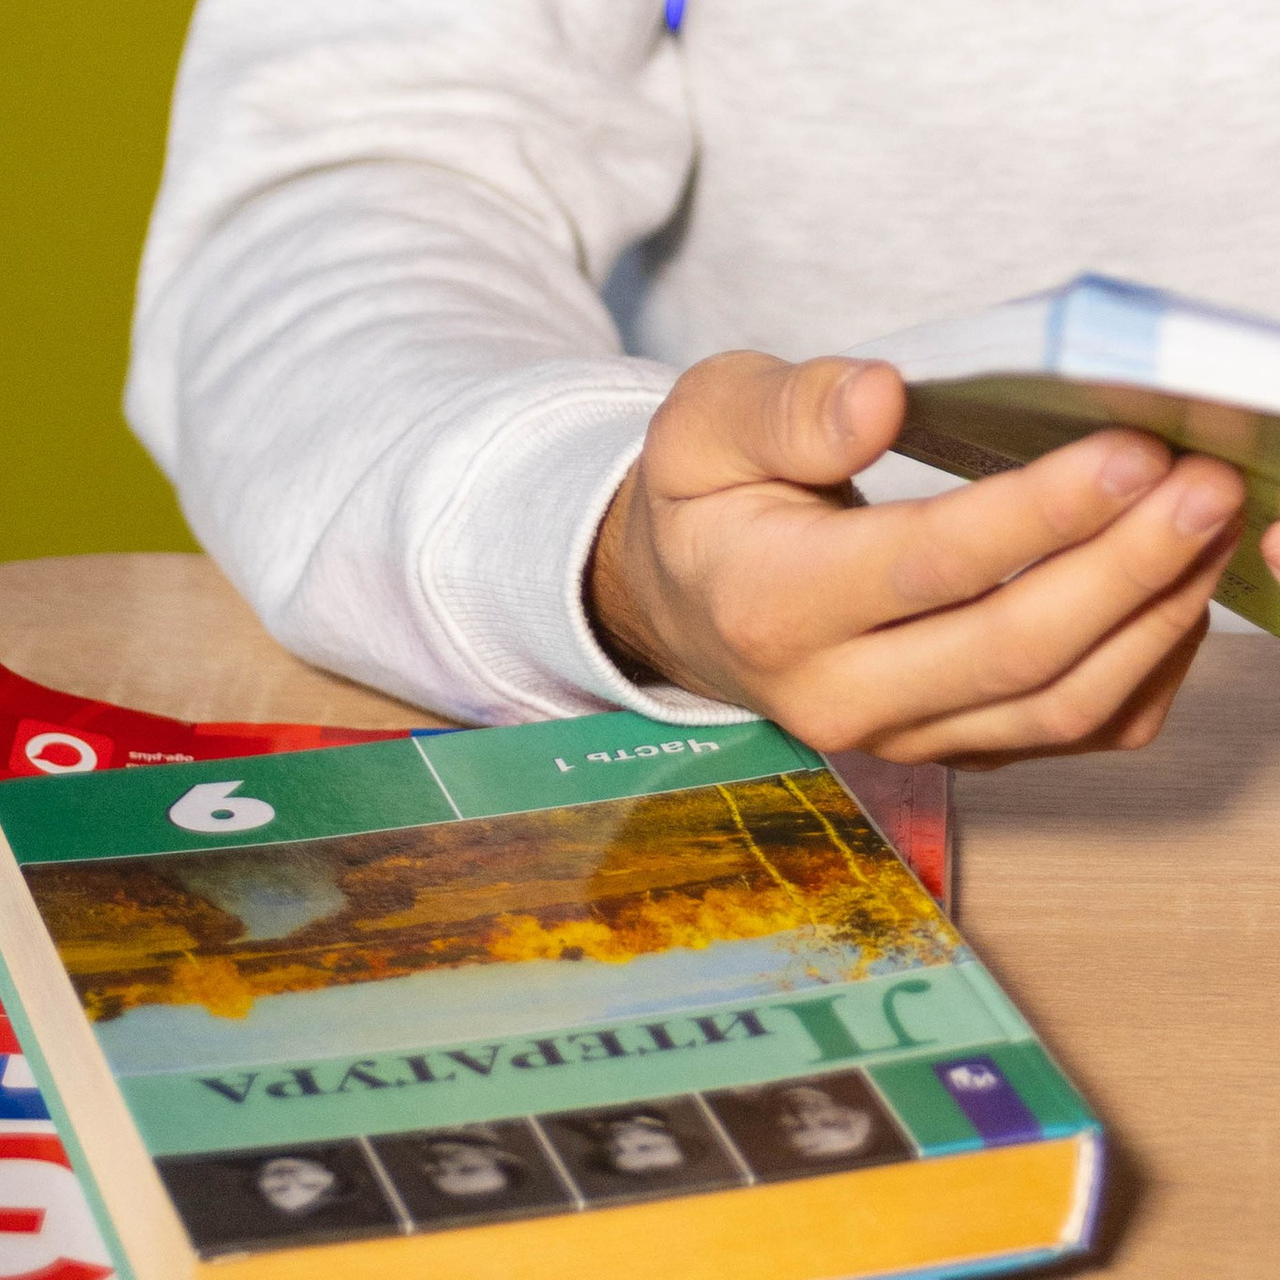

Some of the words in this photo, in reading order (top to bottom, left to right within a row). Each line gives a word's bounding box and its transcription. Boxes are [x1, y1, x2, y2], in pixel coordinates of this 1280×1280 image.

[586, 738, 721, 764] Часть
[553, 757, 576, 773] 1
[165, 780, 276, 833] 9
